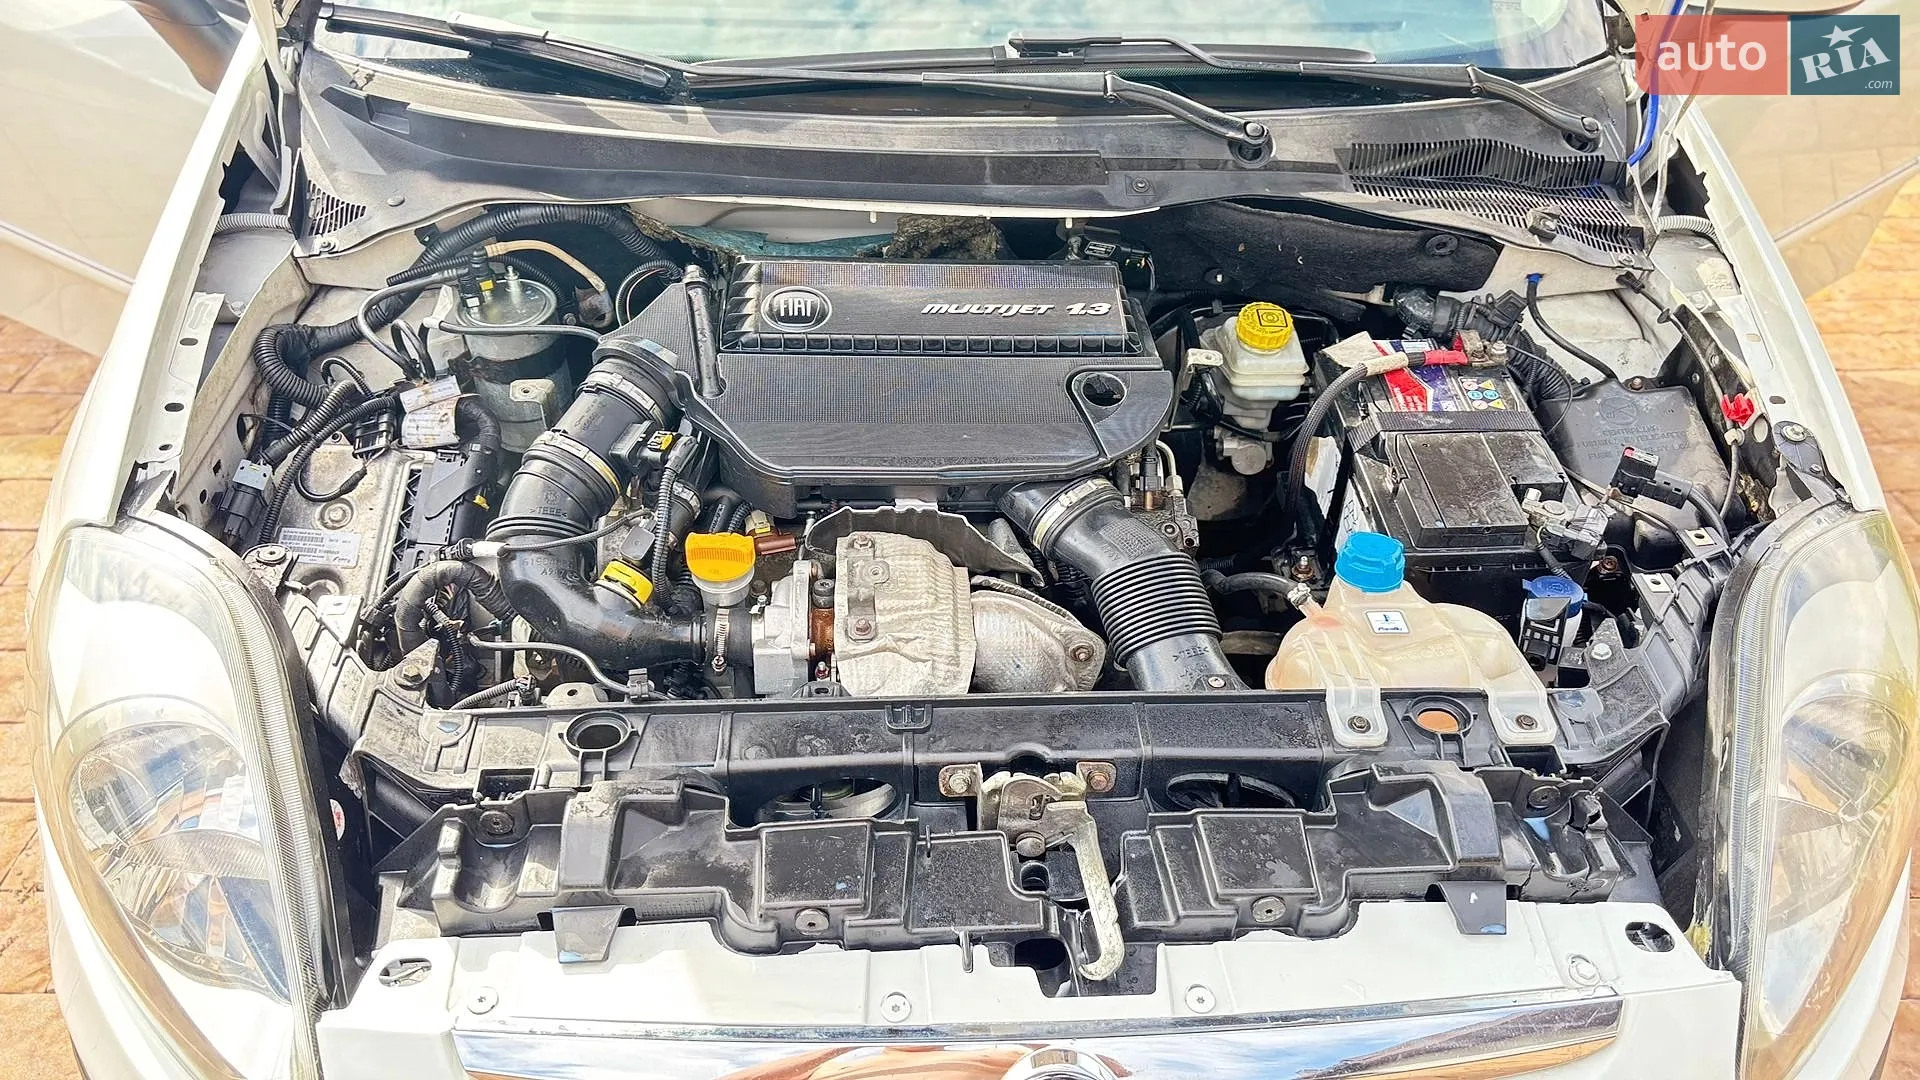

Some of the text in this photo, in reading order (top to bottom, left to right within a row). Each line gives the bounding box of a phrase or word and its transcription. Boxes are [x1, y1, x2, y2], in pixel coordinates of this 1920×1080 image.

[780, 297, 814, 317] FIAT
[921, 302, 1112, 317] MULTIJET 1.3
